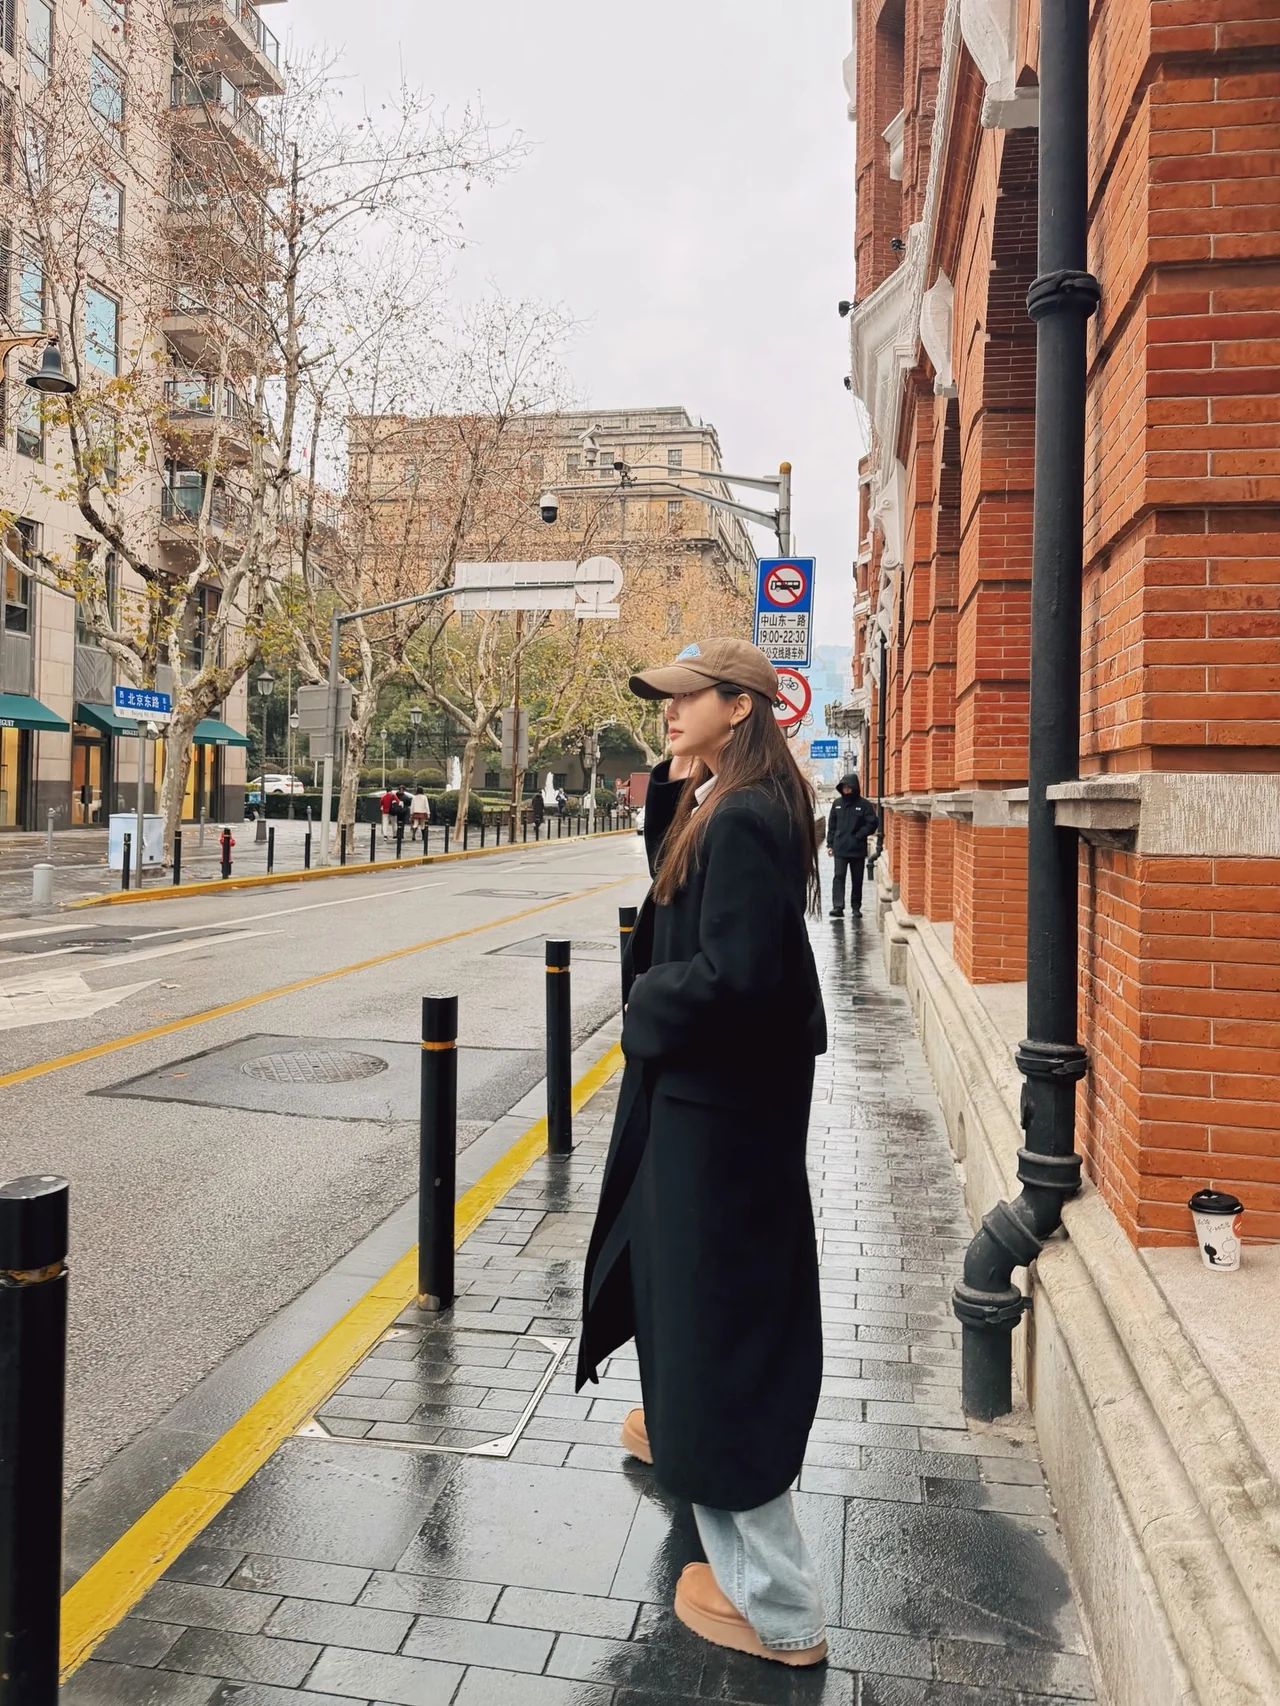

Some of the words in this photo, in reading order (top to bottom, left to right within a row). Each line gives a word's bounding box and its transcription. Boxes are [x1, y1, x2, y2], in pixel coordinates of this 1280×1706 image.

[760, 614, 806, 627] 中山东一路
[760, 630, 805, 643] 19:00-22:30
[128, 692, 159, 708] 北京东路
